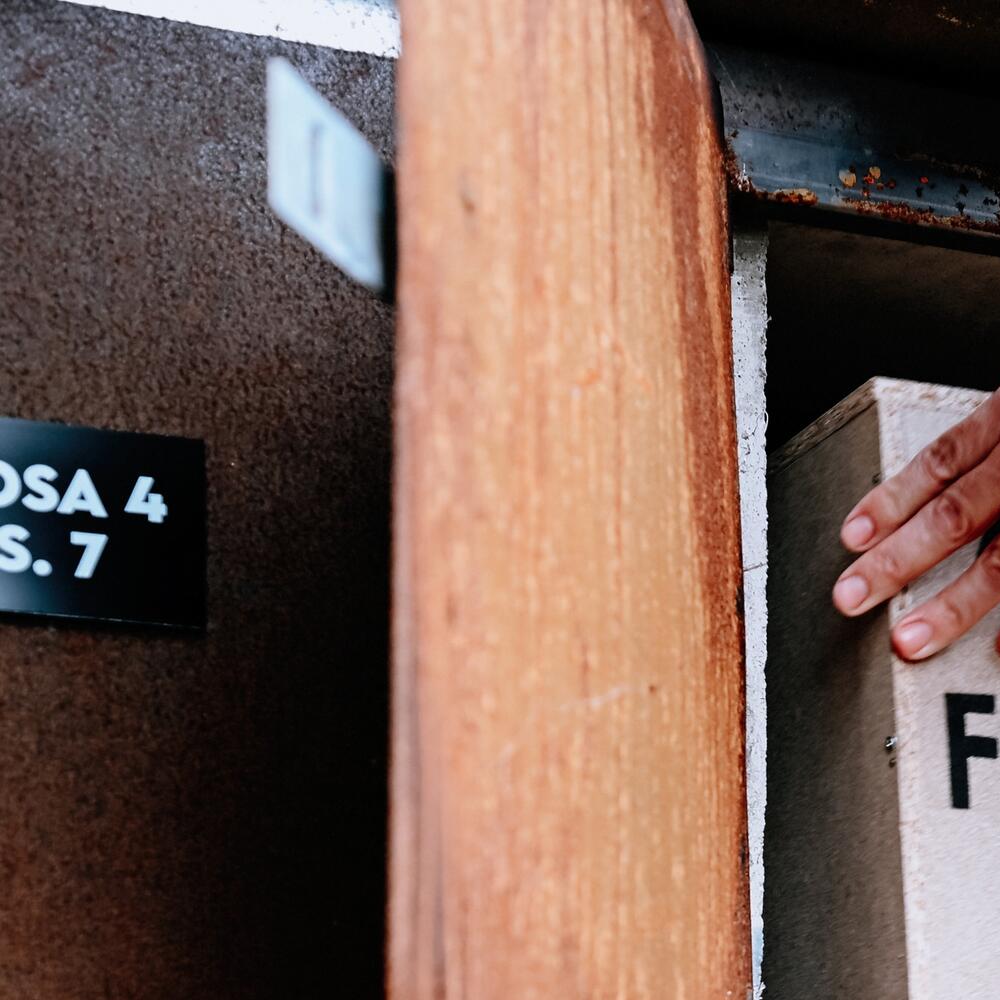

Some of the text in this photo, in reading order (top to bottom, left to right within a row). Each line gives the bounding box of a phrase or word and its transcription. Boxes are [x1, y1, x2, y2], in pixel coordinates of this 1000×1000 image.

[124, 476, 168, 523] 4
[0, 524, 109, 579] S. 7
